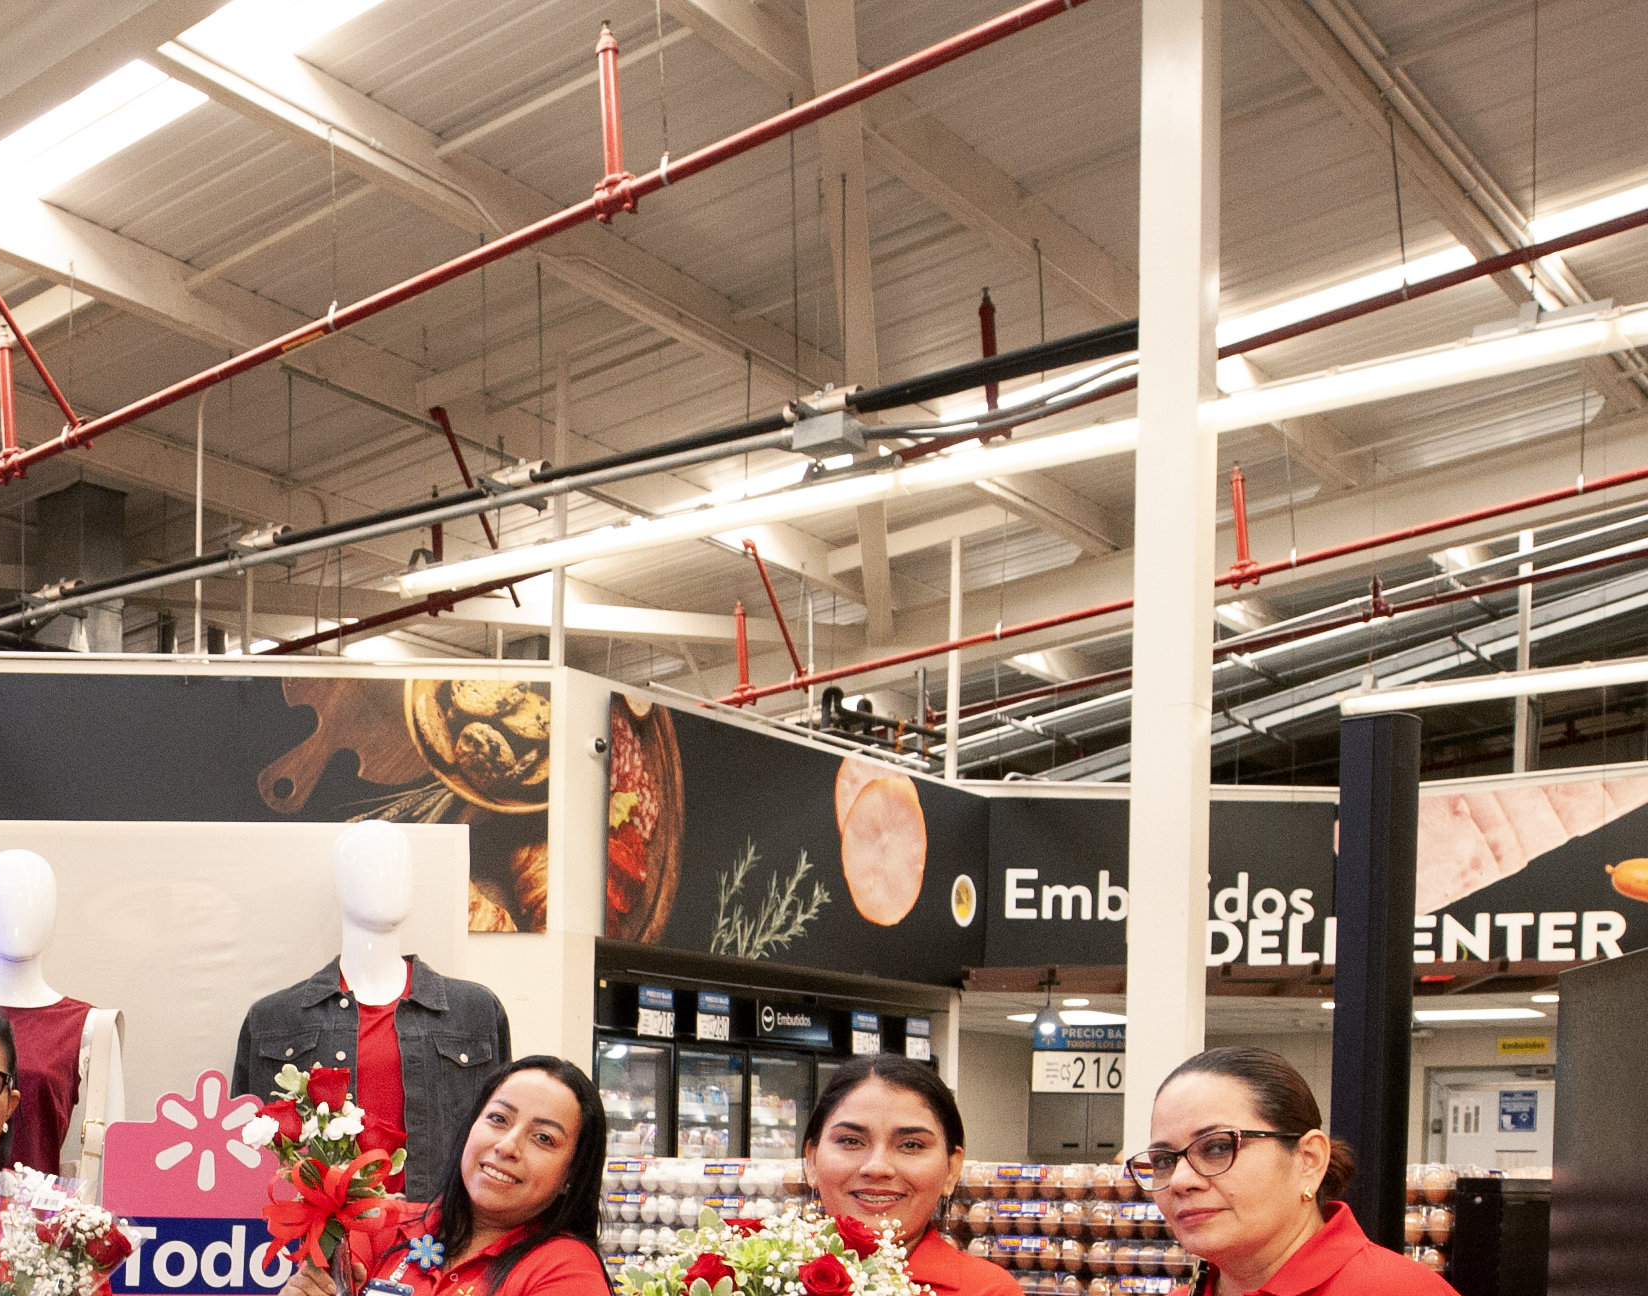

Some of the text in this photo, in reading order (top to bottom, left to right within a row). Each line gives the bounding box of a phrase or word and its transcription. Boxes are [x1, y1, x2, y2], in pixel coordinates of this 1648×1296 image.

[1005, 868, 1315, 924] Embdos
[1413, 910, 1627, 963] ENTER
[1061, 1027, 1105, 1039] PRECIO
[121, 1225, 293, 1288] Todo
